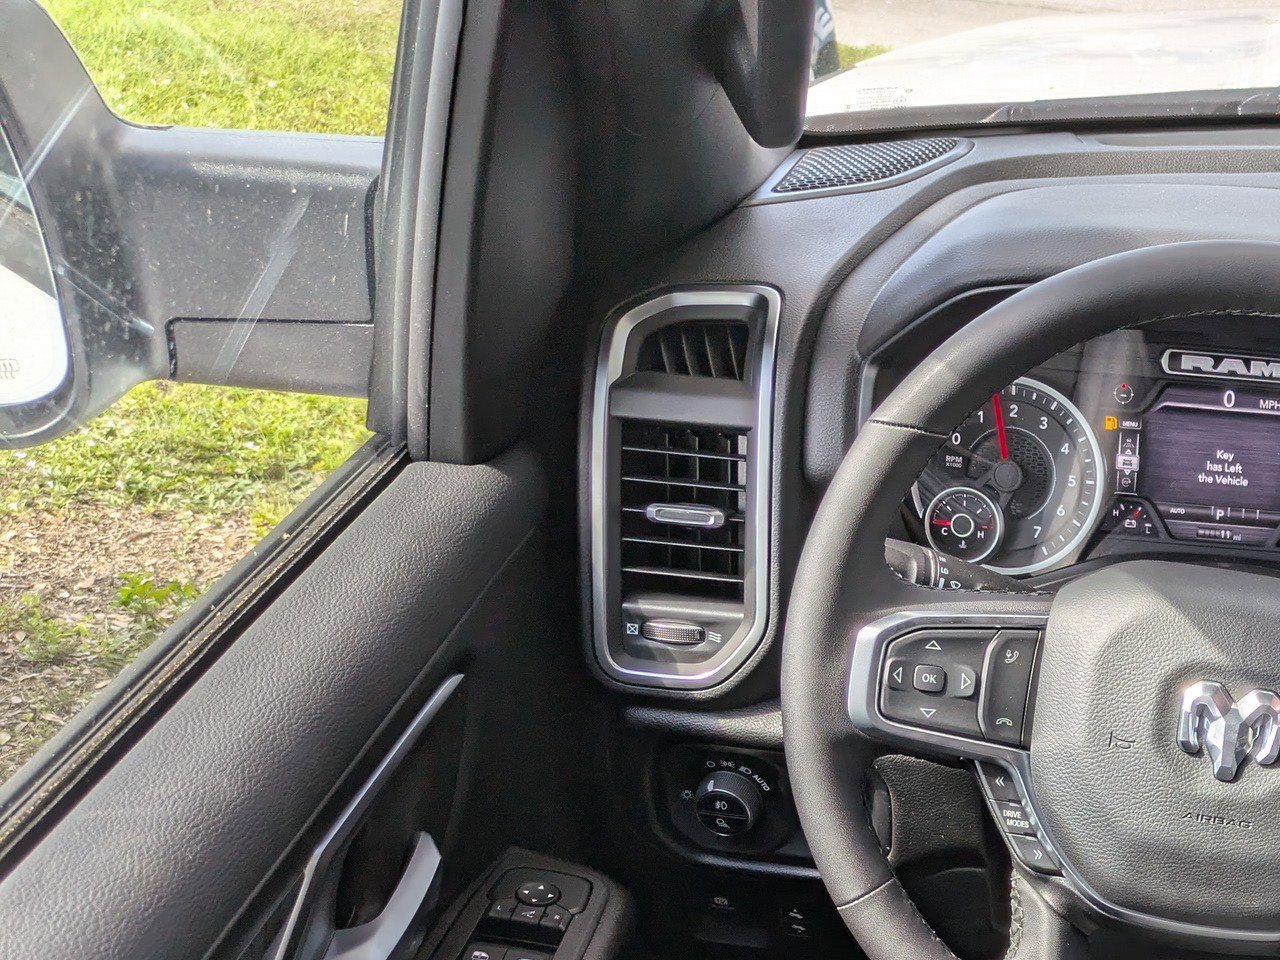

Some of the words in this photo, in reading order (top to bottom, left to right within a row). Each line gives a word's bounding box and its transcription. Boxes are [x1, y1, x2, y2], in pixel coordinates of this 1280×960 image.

[1223, 390, 1235, 408] 0
[977, 411, 985, 423] 1
[1009, 405, 1018, 418] 2
[1039, 417, 1048, 430] 3
[952, 433, 961, 445] 0
[1061, 443, 1070, 455] 4
[946, 455, 962, 463] RPM
[1216, 450, 1234, 462] Key
[1206, 462, 1222, 472] has
[1224, 463, 1242, 474] Left
[1068, 475, 1076, 487] 5
[1198, 474, 1213, 484] the
[1215, 475, 1249, 487] Vehicle
[1057, 505, 1065, 517] 6
[1112, 509, 1119, 518] H
[1216, 509, 1225, 520] P
[941, 527, 948, 536] C
[977, 530, 985, 539] H
[1033, 526, 1042, 538] 7
[922, 673, 937, 684] OK
[752, 774, 770, 791] AUTO
[1003, 809, 1022, 819] DRIVE
[1006, 818, 1030, 828] MODES
[1182, 812, 1252, 829] AIRBAG
